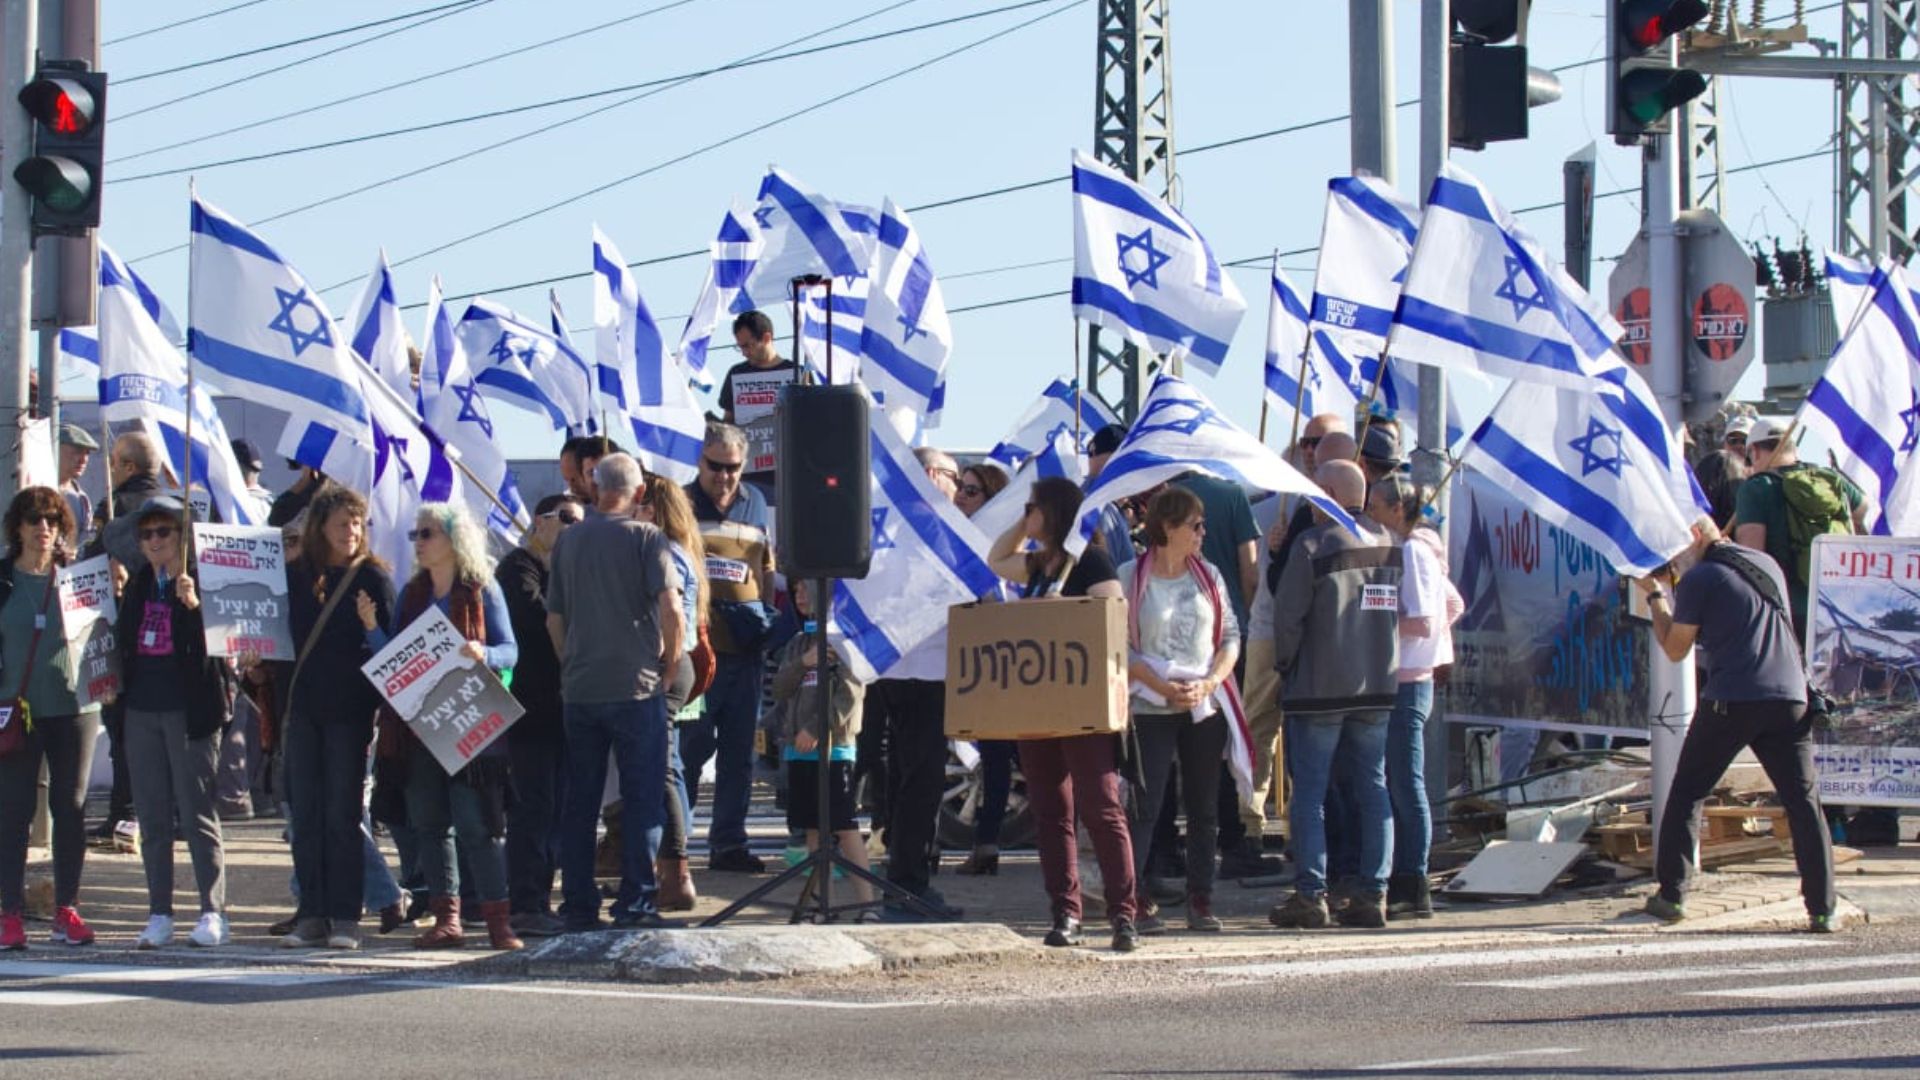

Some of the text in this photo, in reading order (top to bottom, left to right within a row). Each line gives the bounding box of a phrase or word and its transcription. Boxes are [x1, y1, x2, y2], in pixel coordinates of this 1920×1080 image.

[198, 532, 281, 555] מי שהפקיר
[255, 556, 278, 571] את
[213, 595, 279, 618] לא יציל
[236, 618, 263, 634] את
[100, 632, 114, 652] לא
[372, 620, 449, 678] מי שהפקיר
[386, 637, 456, 694] את הדרום
[957, 639, 1088, 694] הופקרנו
[421, 674, 486, 730] לא יציל
[452, 704, 482, 734] את
[456, 712, 506, 759] הצפון
